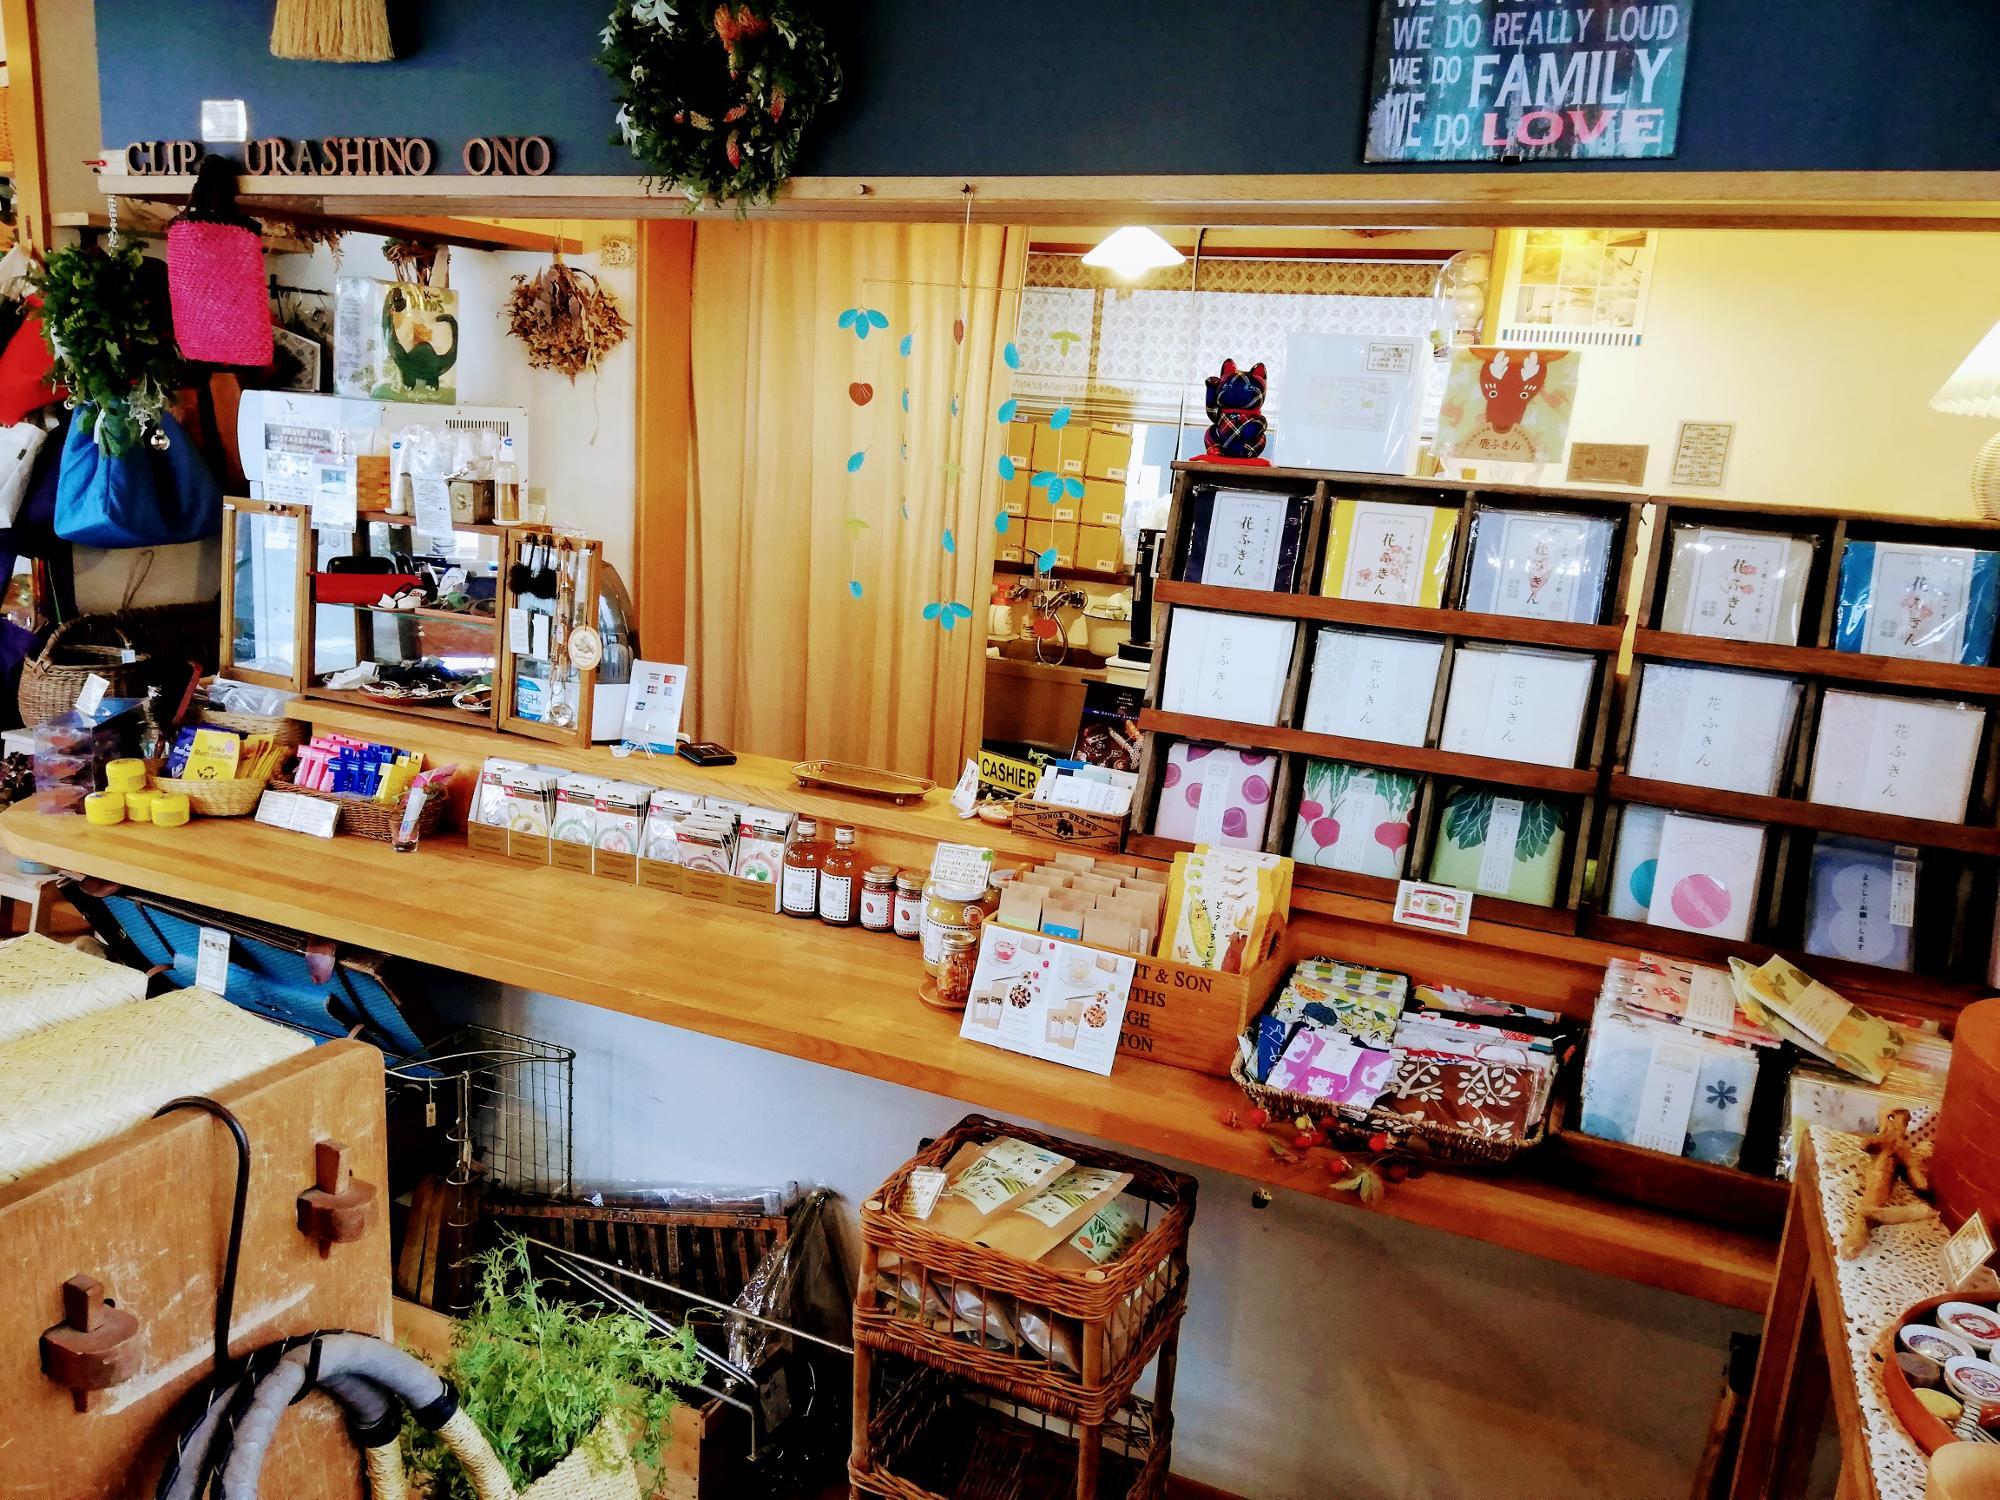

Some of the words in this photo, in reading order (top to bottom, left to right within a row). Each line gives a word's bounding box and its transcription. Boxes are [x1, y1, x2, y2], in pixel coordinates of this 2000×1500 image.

[1393, 16, 1434, 50] WE
[1444, 14, 1481, 49] DO
[1492, 8, 1594, 47] REALLY
[1605, 4, 1679, 42] LOUD
[1389, 57, 1423, 85] WE
[1431, 55, 1462, 84] DO
[1469, 48, 1673, 108] FAMILY
[1384, 92, 1425, 147] WE
[1434, 113, 1470, 147] DO
[1482, 108, 1664, 146] LOVE
[126, 141, 197, 176] CLIP
[463, 136, 550, 176] ONO
[1234, 516, 1254, 576] 花ふきん
[1374, 532, 1396, 595] 花ふきん
[1526, 541, 1549, 605] 花ふきん
[1723, 558, 1748, 626] 花ふきん
[1211, 635, 1232, 700] 花ふきん
[1360, 659, 1384, 724] 花ふきん
[1502, 674, 1527, 742] 花ふきん
[1696, 696, 1721, 767] 花ふきん
[982, 758, 1036, 789] CASHIER
[1881, 723, 1910, 797] 花ふきん
[1858, 873, 1869, 951] よろしくお願いします
[1129, 987, 1166, 1008] THS
[1155, 969, 1168, 984] &
[1174, 971, 1213, 993] SON
[1126, 1010, 1150, 1029] GE
